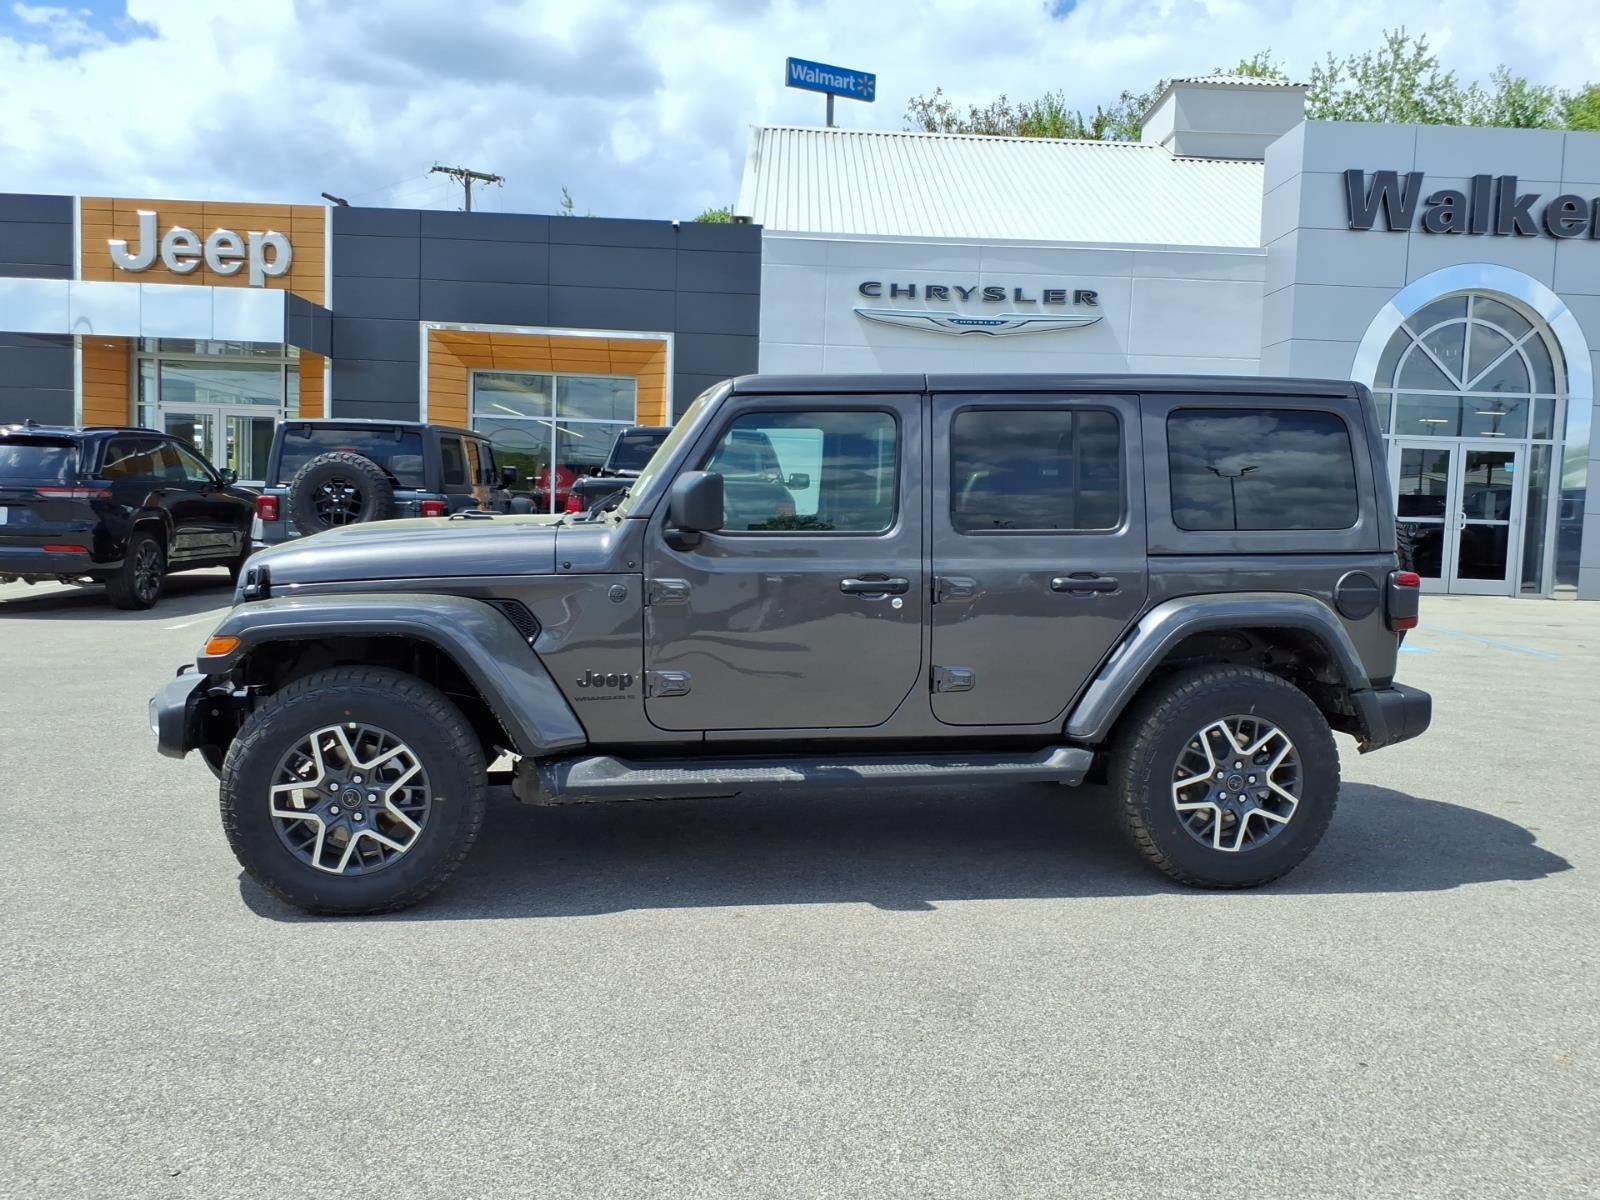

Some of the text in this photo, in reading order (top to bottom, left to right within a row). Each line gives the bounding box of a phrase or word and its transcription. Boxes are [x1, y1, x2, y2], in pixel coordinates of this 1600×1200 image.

[791, 63, 856, 91] Walmart
[1344, 169, 1600, 240] Walke
[107, 209, 292, 288] Jeep
[858, 281, 1098, 306] CHRYSLER
[576, 668, 633, 691] Jeep
